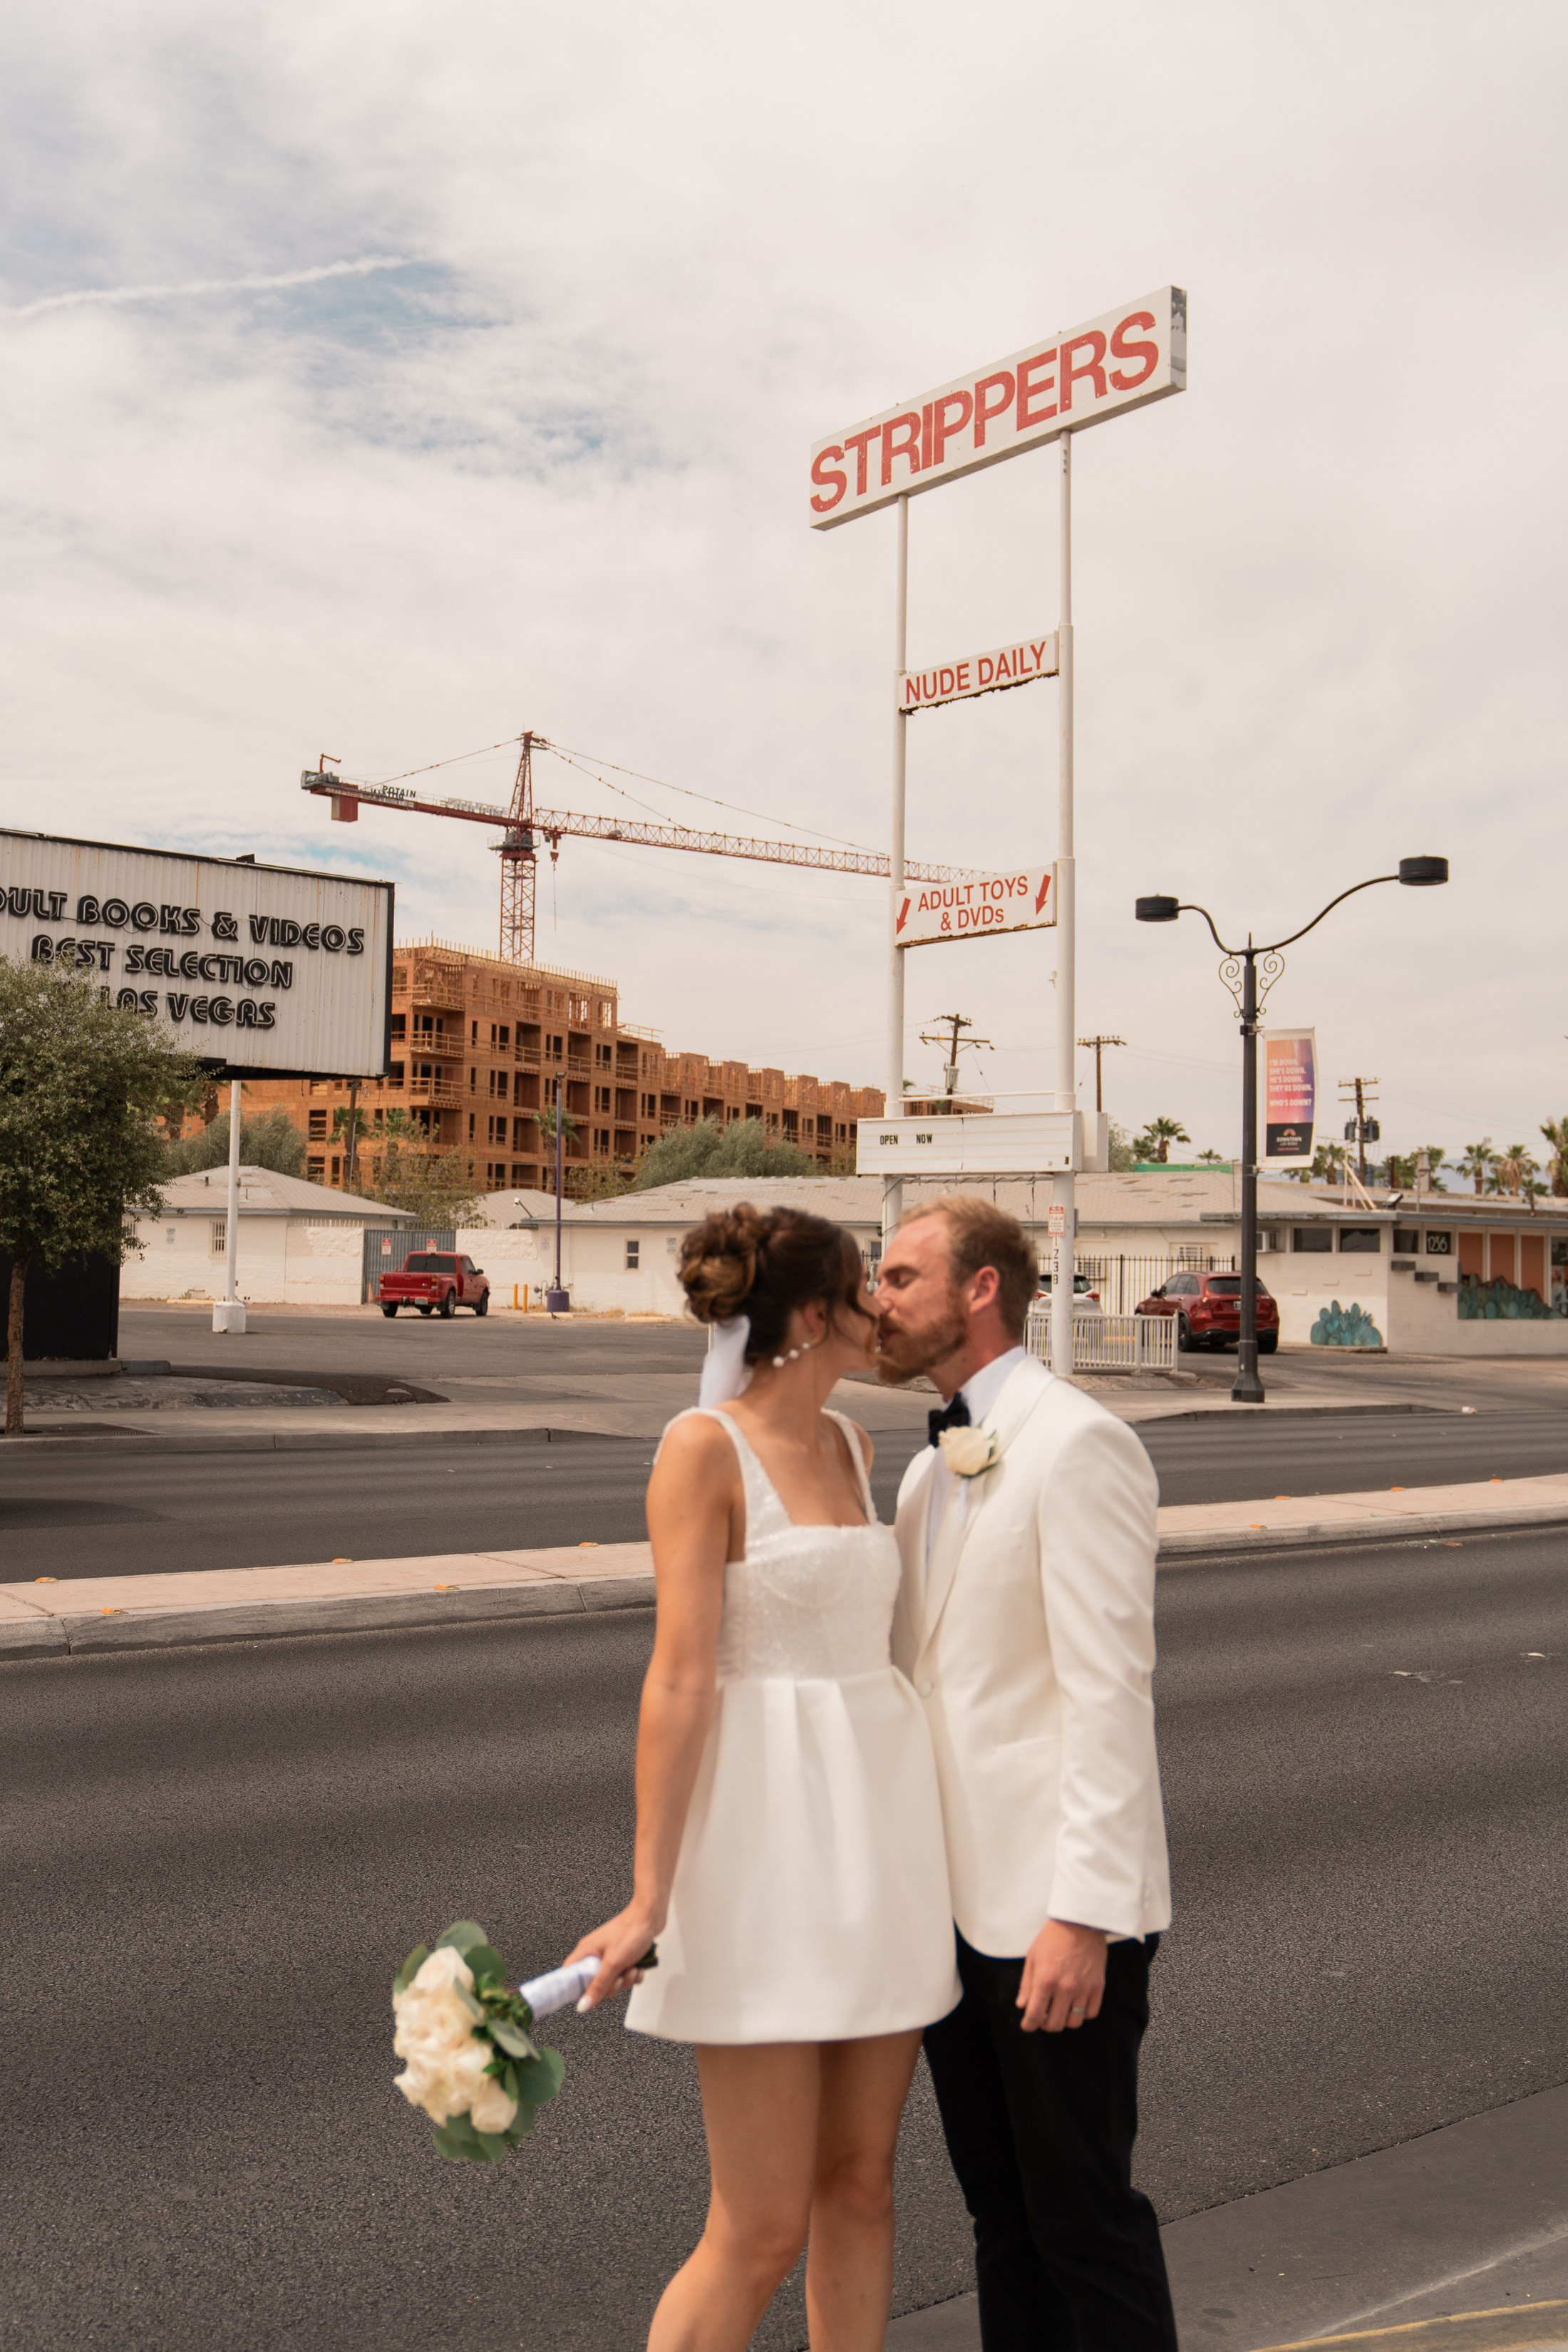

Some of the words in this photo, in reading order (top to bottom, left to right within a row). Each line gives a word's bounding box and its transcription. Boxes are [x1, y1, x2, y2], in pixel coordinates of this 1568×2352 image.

[810, 311, 1159, 512] STRIPPERS
[906, 662, 971, 704] NUDE
[978, 641, 1046, 686] DAILY
[383, 785, 416, 798] POTAIN
[918, 884, 974, 912] ADULT
[979, 875, 1028, 902] TOYS
[0, 887, 67, 921] ULT
[77, 894, 200, 935] BOOKS
[212, 912, 238, 941] &
[249, 914, 364, 954] VIDEOS
[941, 912, 951, 932] &
[958, 905, 1004, 929] DVDs
[31, 934, 115, 970] BEST
[125, 944, 293, 989] SELECTION
[167, 991, 276, 1028] VEGAS
[880, 1135, 898, 1145] OPEN
[916, 1134, 932, 1144] NOW
